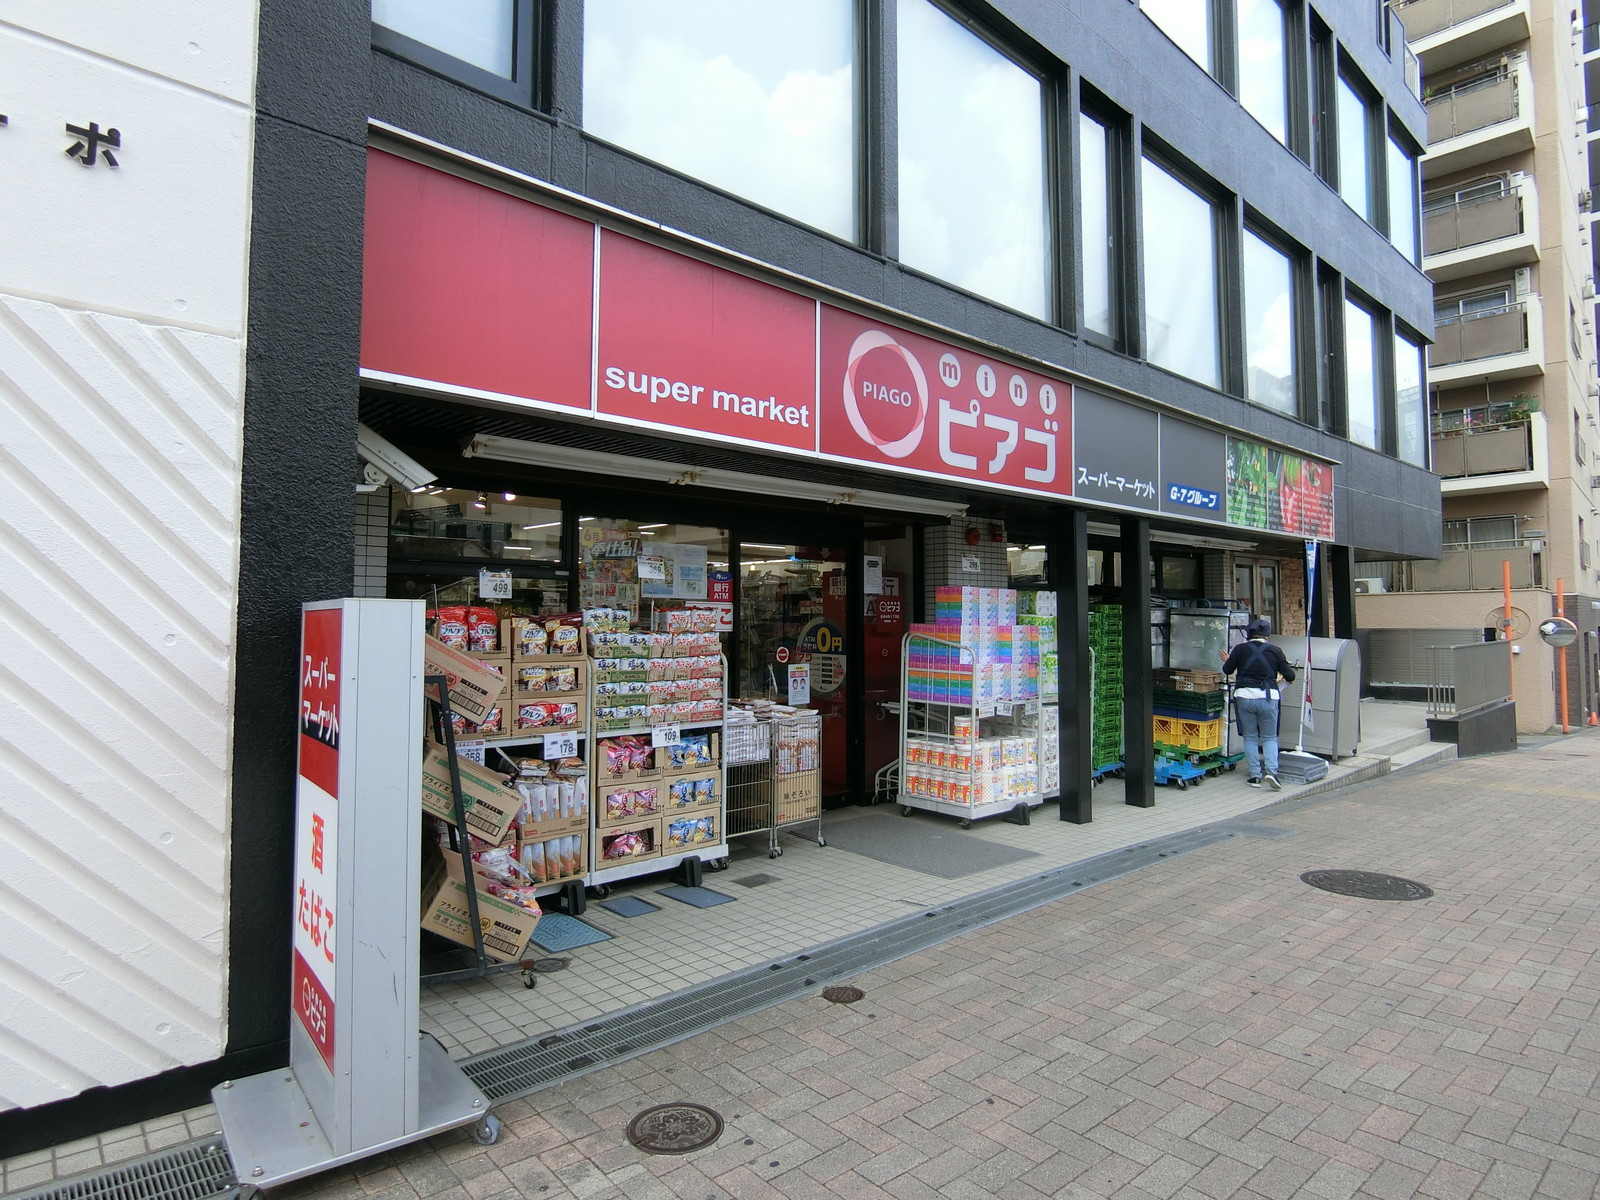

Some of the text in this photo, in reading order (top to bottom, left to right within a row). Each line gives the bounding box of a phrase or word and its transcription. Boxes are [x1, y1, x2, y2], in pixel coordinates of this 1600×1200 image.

[604, 366, 809, 428] super market
[863, 380, 912, 408] PIAGO
[941, 359, 1051, 411] mini
[938, 398, 1059, 484] ピアゴ
[1078, 466, 1156, 500] スーパーマーケット
[492, 582, 508, 593] 499
[713, 583, 729, 592] 銀行
[714, 592, 729, 600] ATM
[304, 655, 336, 690] スーパー
[303, 700, 339, 745] マーケット
[664, 730, 677, 742] 109
[559, 742, 574, 754] 178
[423, 775, 454, 795] プライドポ
[311, 812, 324, 875] 酒
[298, 878, 334, 964] たばこ
[440, 900, 472, 919] プライドポテ
